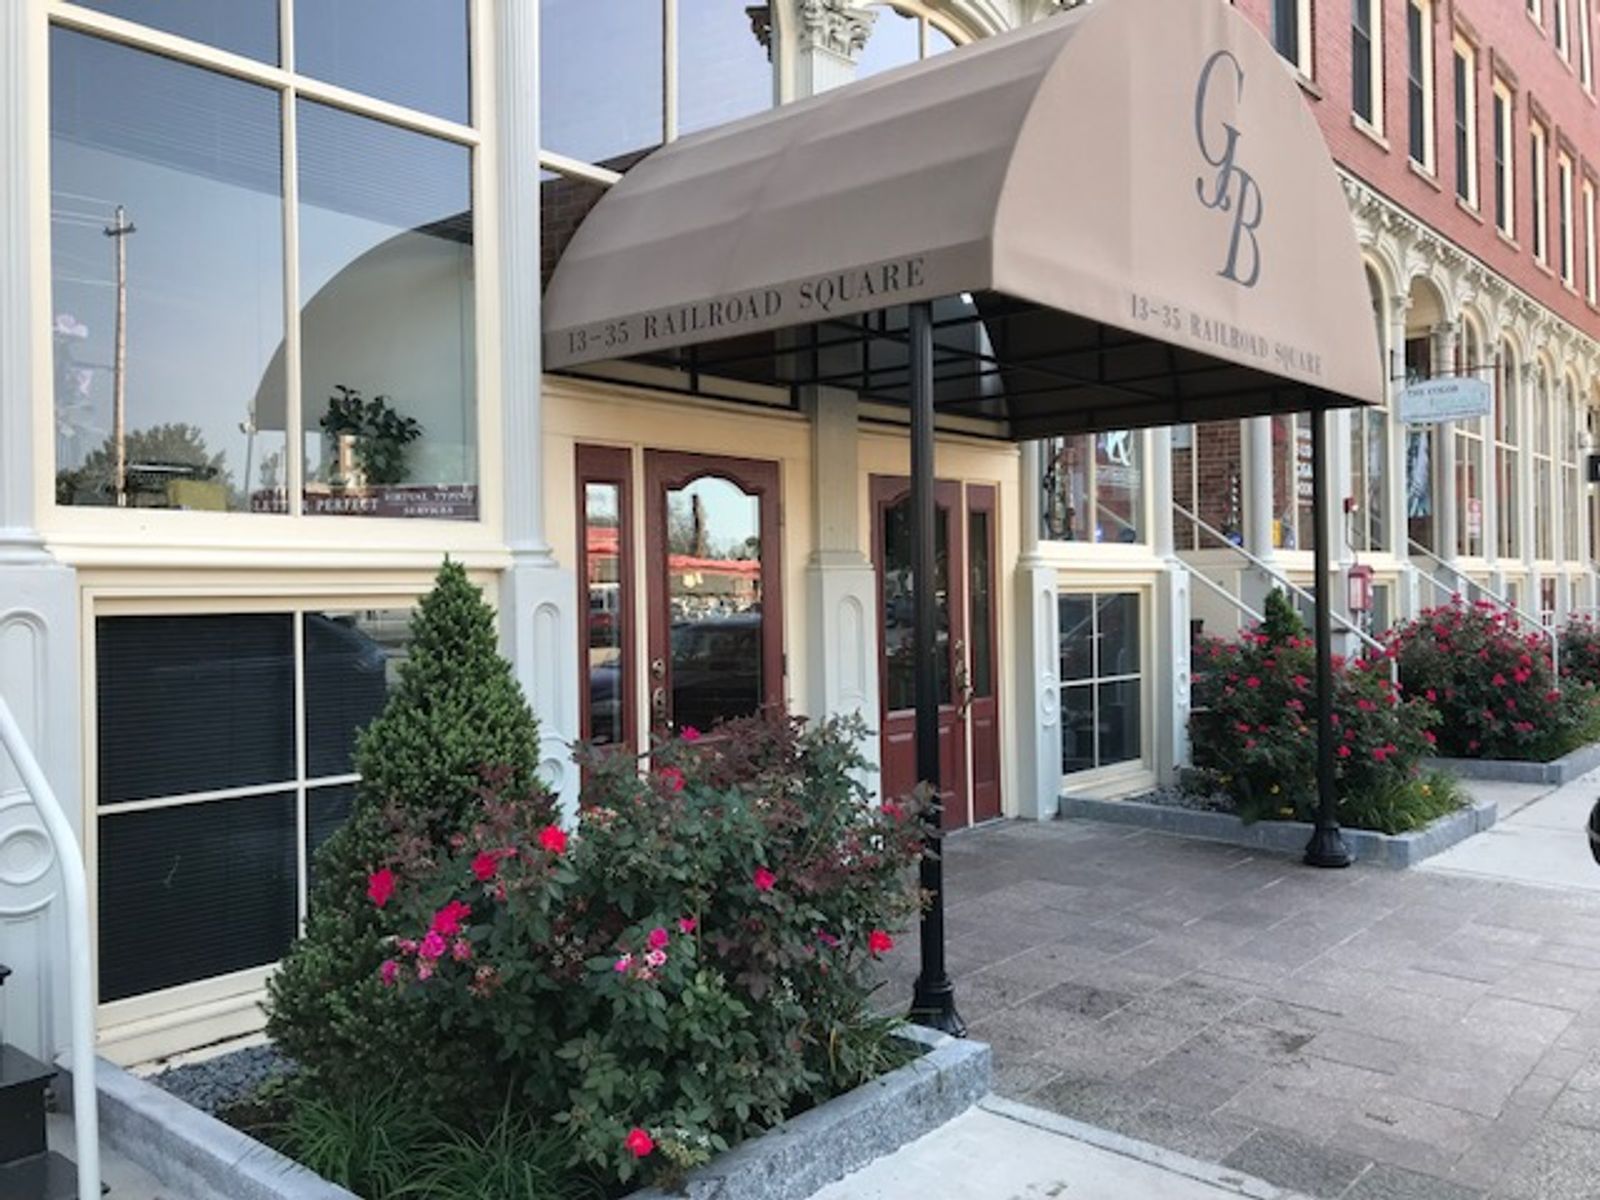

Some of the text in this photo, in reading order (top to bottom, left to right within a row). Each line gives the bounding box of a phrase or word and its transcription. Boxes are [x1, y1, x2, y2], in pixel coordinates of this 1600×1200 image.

[567, 257, 925, 355] 13-35 RAILROAD SQUARE
[1131, 293, 1322, 377] 13-35 RAILROAD SQUARE
[315, 496, 379, 512] PERFECT
